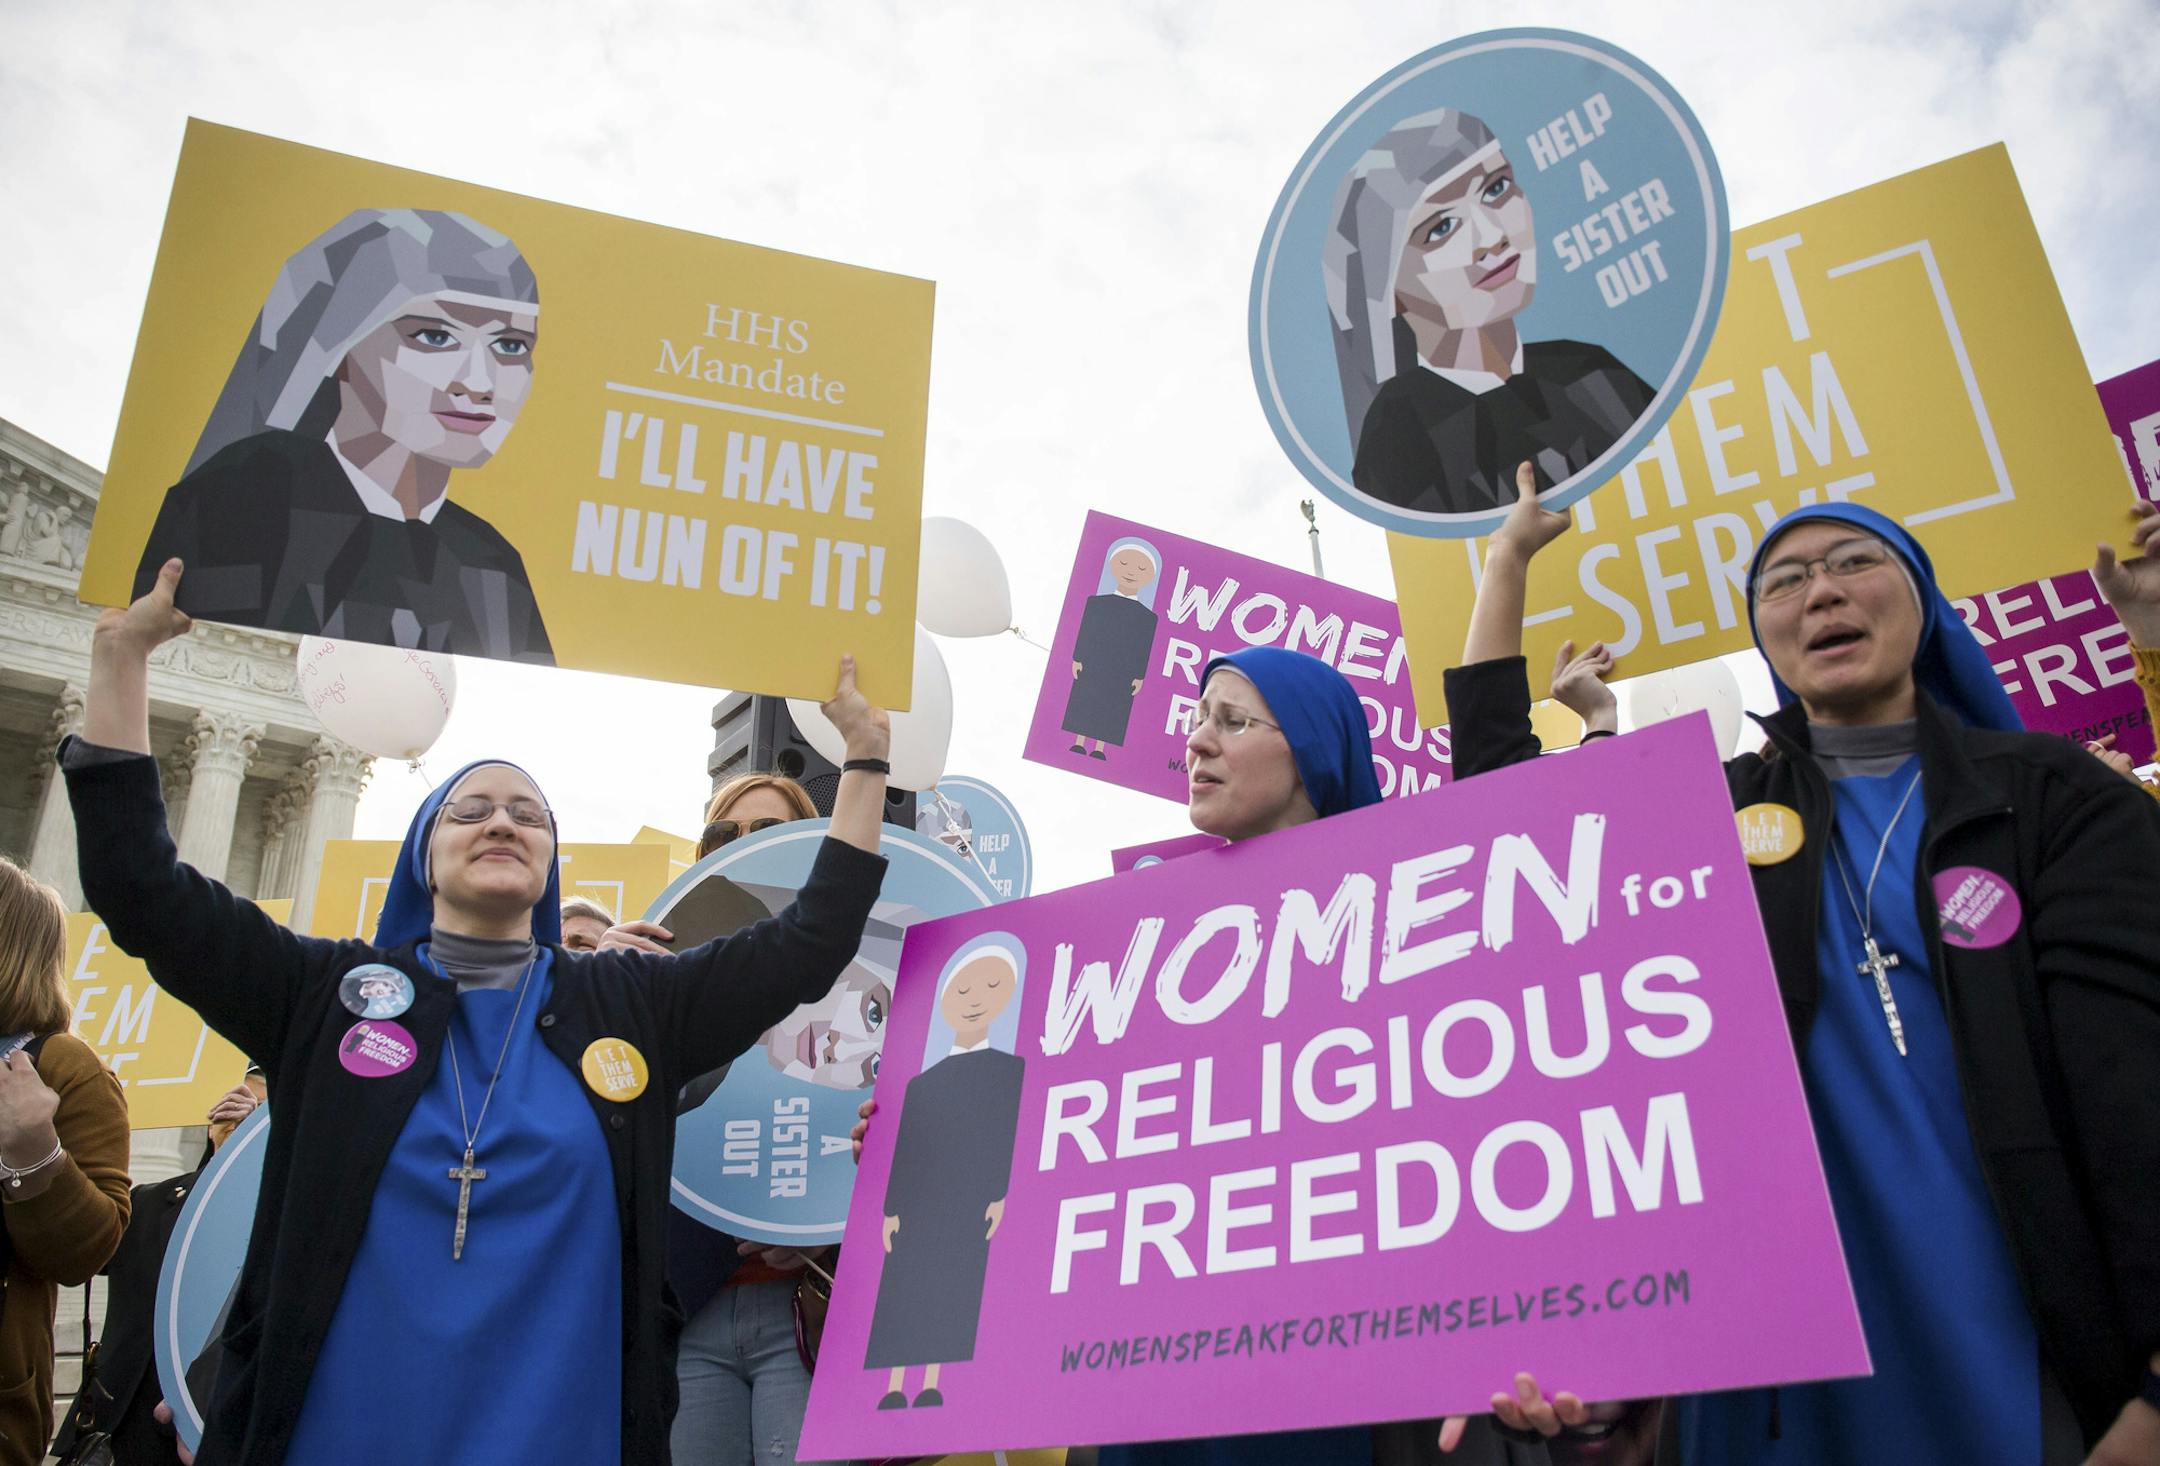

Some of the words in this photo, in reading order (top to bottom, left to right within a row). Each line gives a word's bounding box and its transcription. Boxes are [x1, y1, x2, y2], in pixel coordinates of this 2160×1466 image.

[1526, 92, 1613, 171] HELP
[1580, 159, 1610, 202] A
[1551, 177, 1675, 273] SISTER
[1595, 241, 1669, 309] OUT
[703, 303, 809, 354] HHS
[654, 338, 846, 405] Mandate
[598, 410, 708, 494] I'LL
[722, 430, 879, 521] HAVE
[571, 500, 707, 590] NUN
[719, 523, 799, 601] OF
[810, 537, 886, 615] IT!
[979, 833, 1010, 853] HELP
[1743, 825, 1783, 839] THEM
[1743, 838, 1784, 855] SERVE
[988, 857, 997, 875] A
[1040, 812, 1606, 1056] WOMEN
[1619, 865, 1713, 917] for
[366, 1029, 410, 1055] WOMEN
[594, 1045, 627, 1064] LET
[600, 1059, 634, 1078] THEM
[1038, 954, 1713, 1172] RELIGIOUS
[606, 1073, 639, 1091] SERVE
[722, 1119, 761, 1178] OUT
[769, 1097, 810, 1199] SISTER
[820, 1134, 853, 1156] A
[1050, 1091, 1704, 1294] FREEDOM
[1060, 1268, 1691, 1374] WOMENSPEAKFORTHEMSELVES.COM
